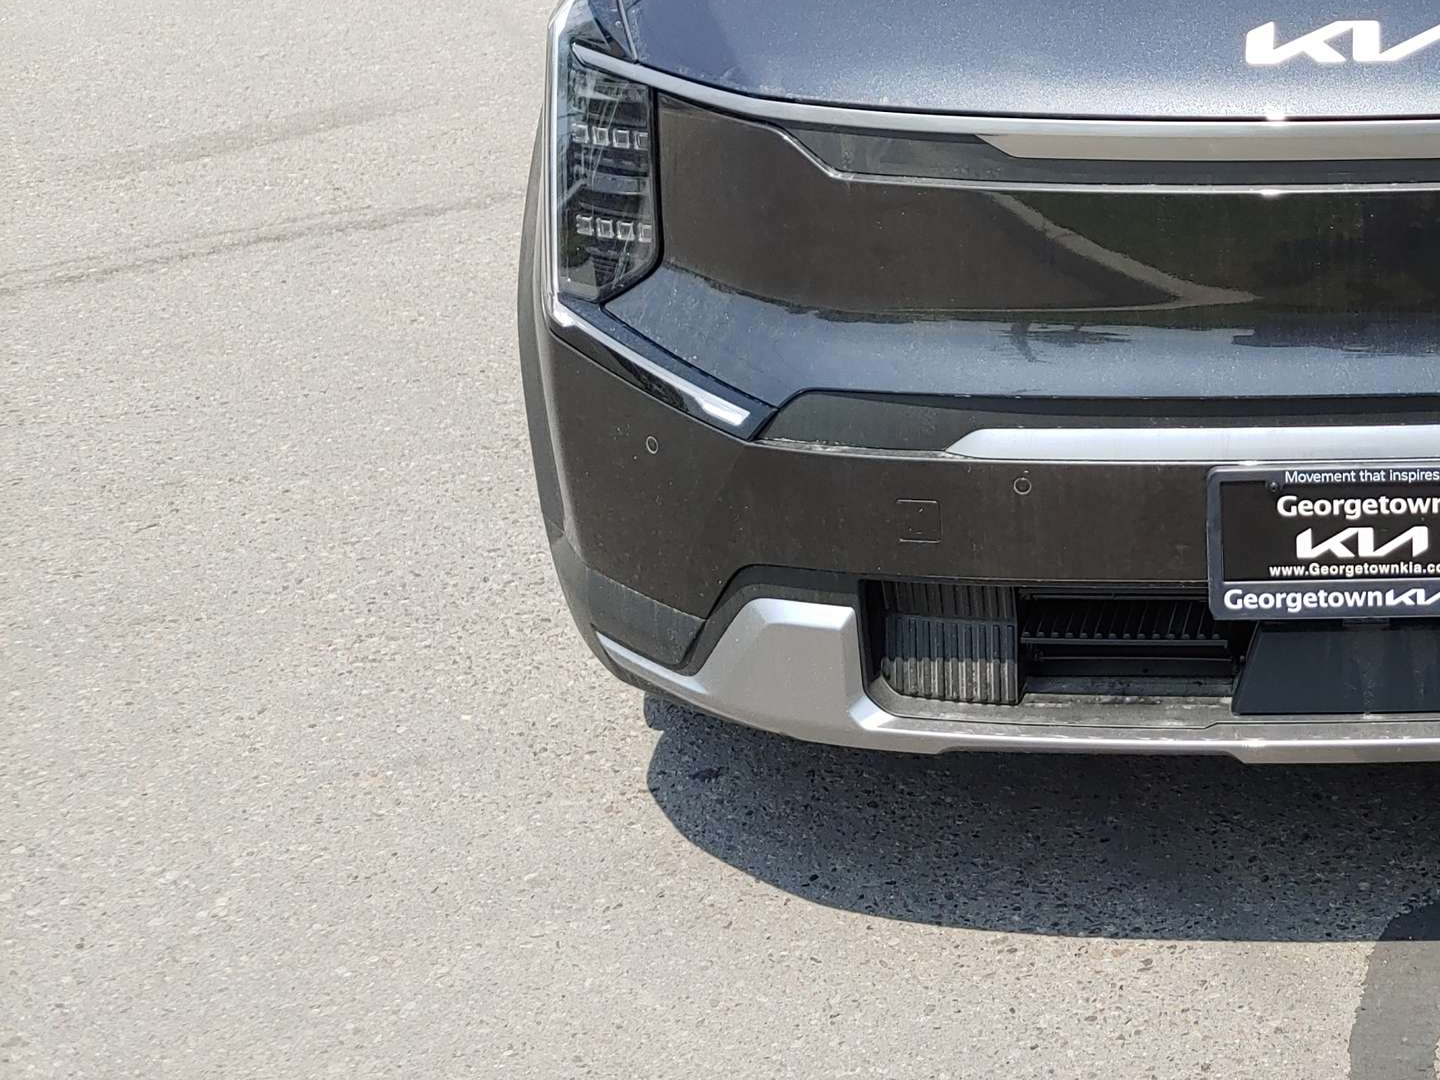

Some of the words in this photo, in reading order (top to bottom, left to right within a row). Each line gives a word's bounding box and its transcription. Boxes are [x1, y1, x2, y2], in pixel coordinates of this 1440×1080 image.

[1285, 470, 1357, 484] Movement
[1359, 470, 1386, 482] that
[1389, 469, 1440, 483] inspires
